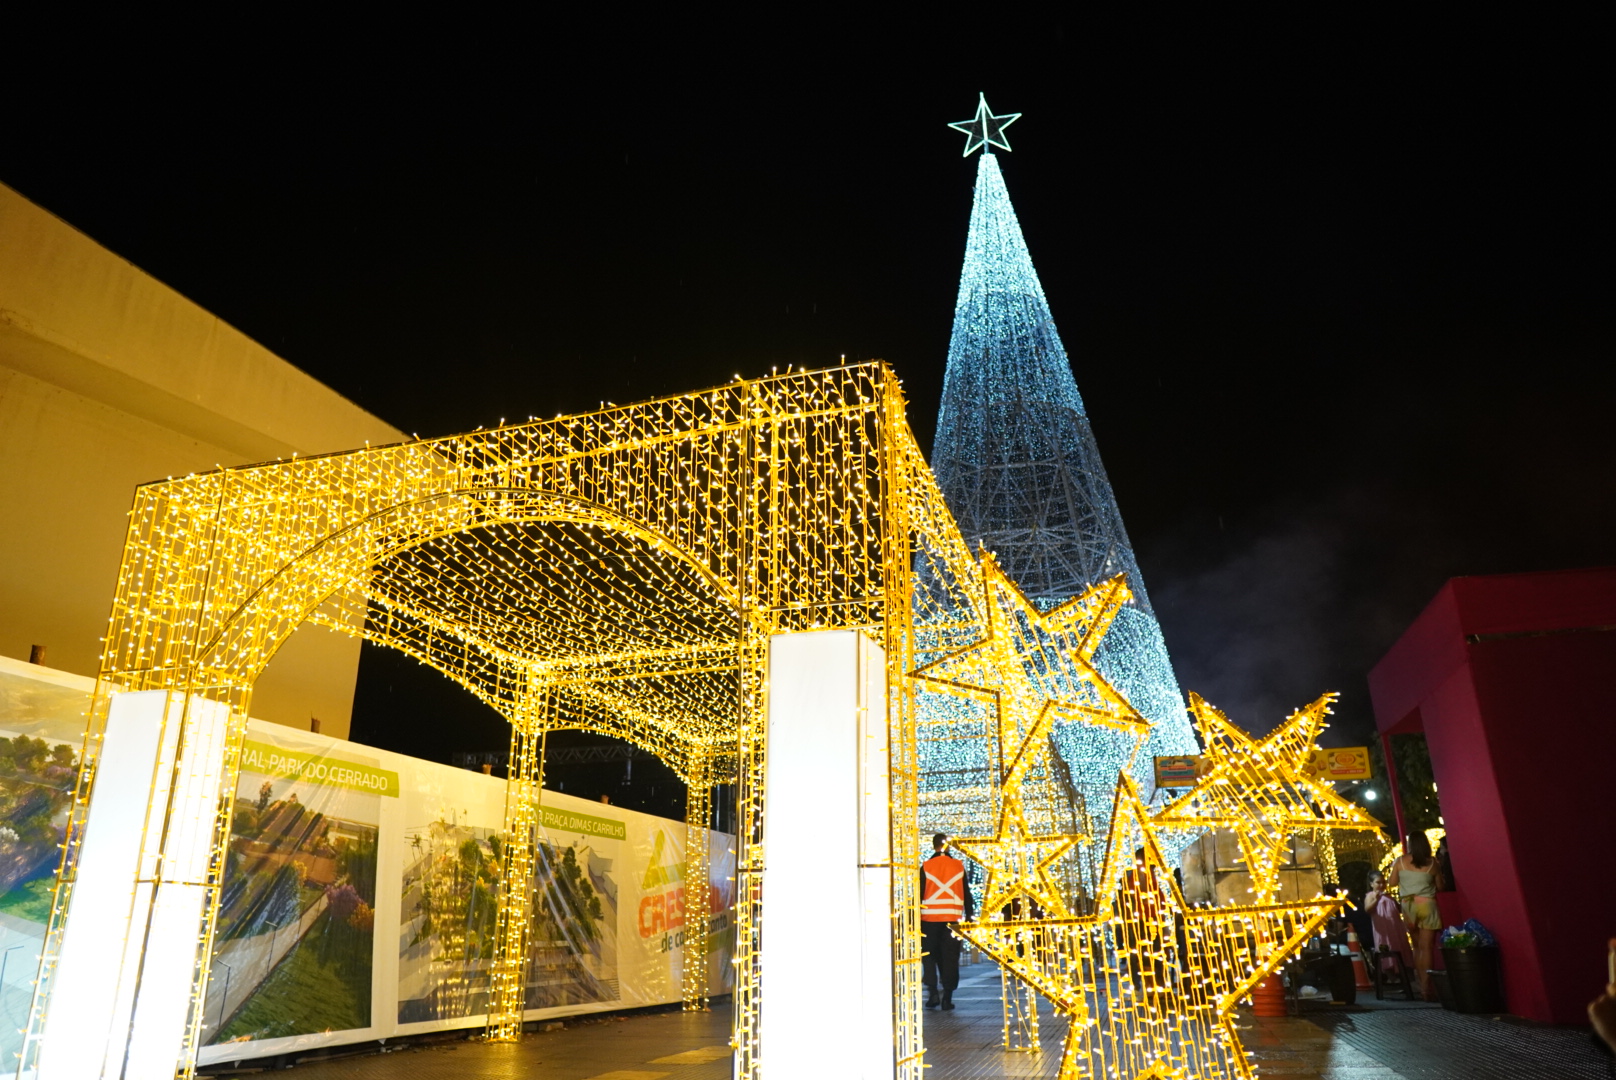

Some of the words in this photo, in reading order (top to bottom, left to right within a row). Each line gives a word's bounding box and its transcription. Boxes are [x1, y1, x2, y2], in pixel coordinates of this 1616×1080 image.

[268, 753, 306, 776] PARK
[306, 761, 327, 780] DO
[329, 765, 388, 791] CERRADO
[544, 812, 568, 829] PRAÇA
[569, 817, 592, 832] DIMAS
[592, 821, 624, 838] CARRILHO
[661, 932, 673, 953] de
